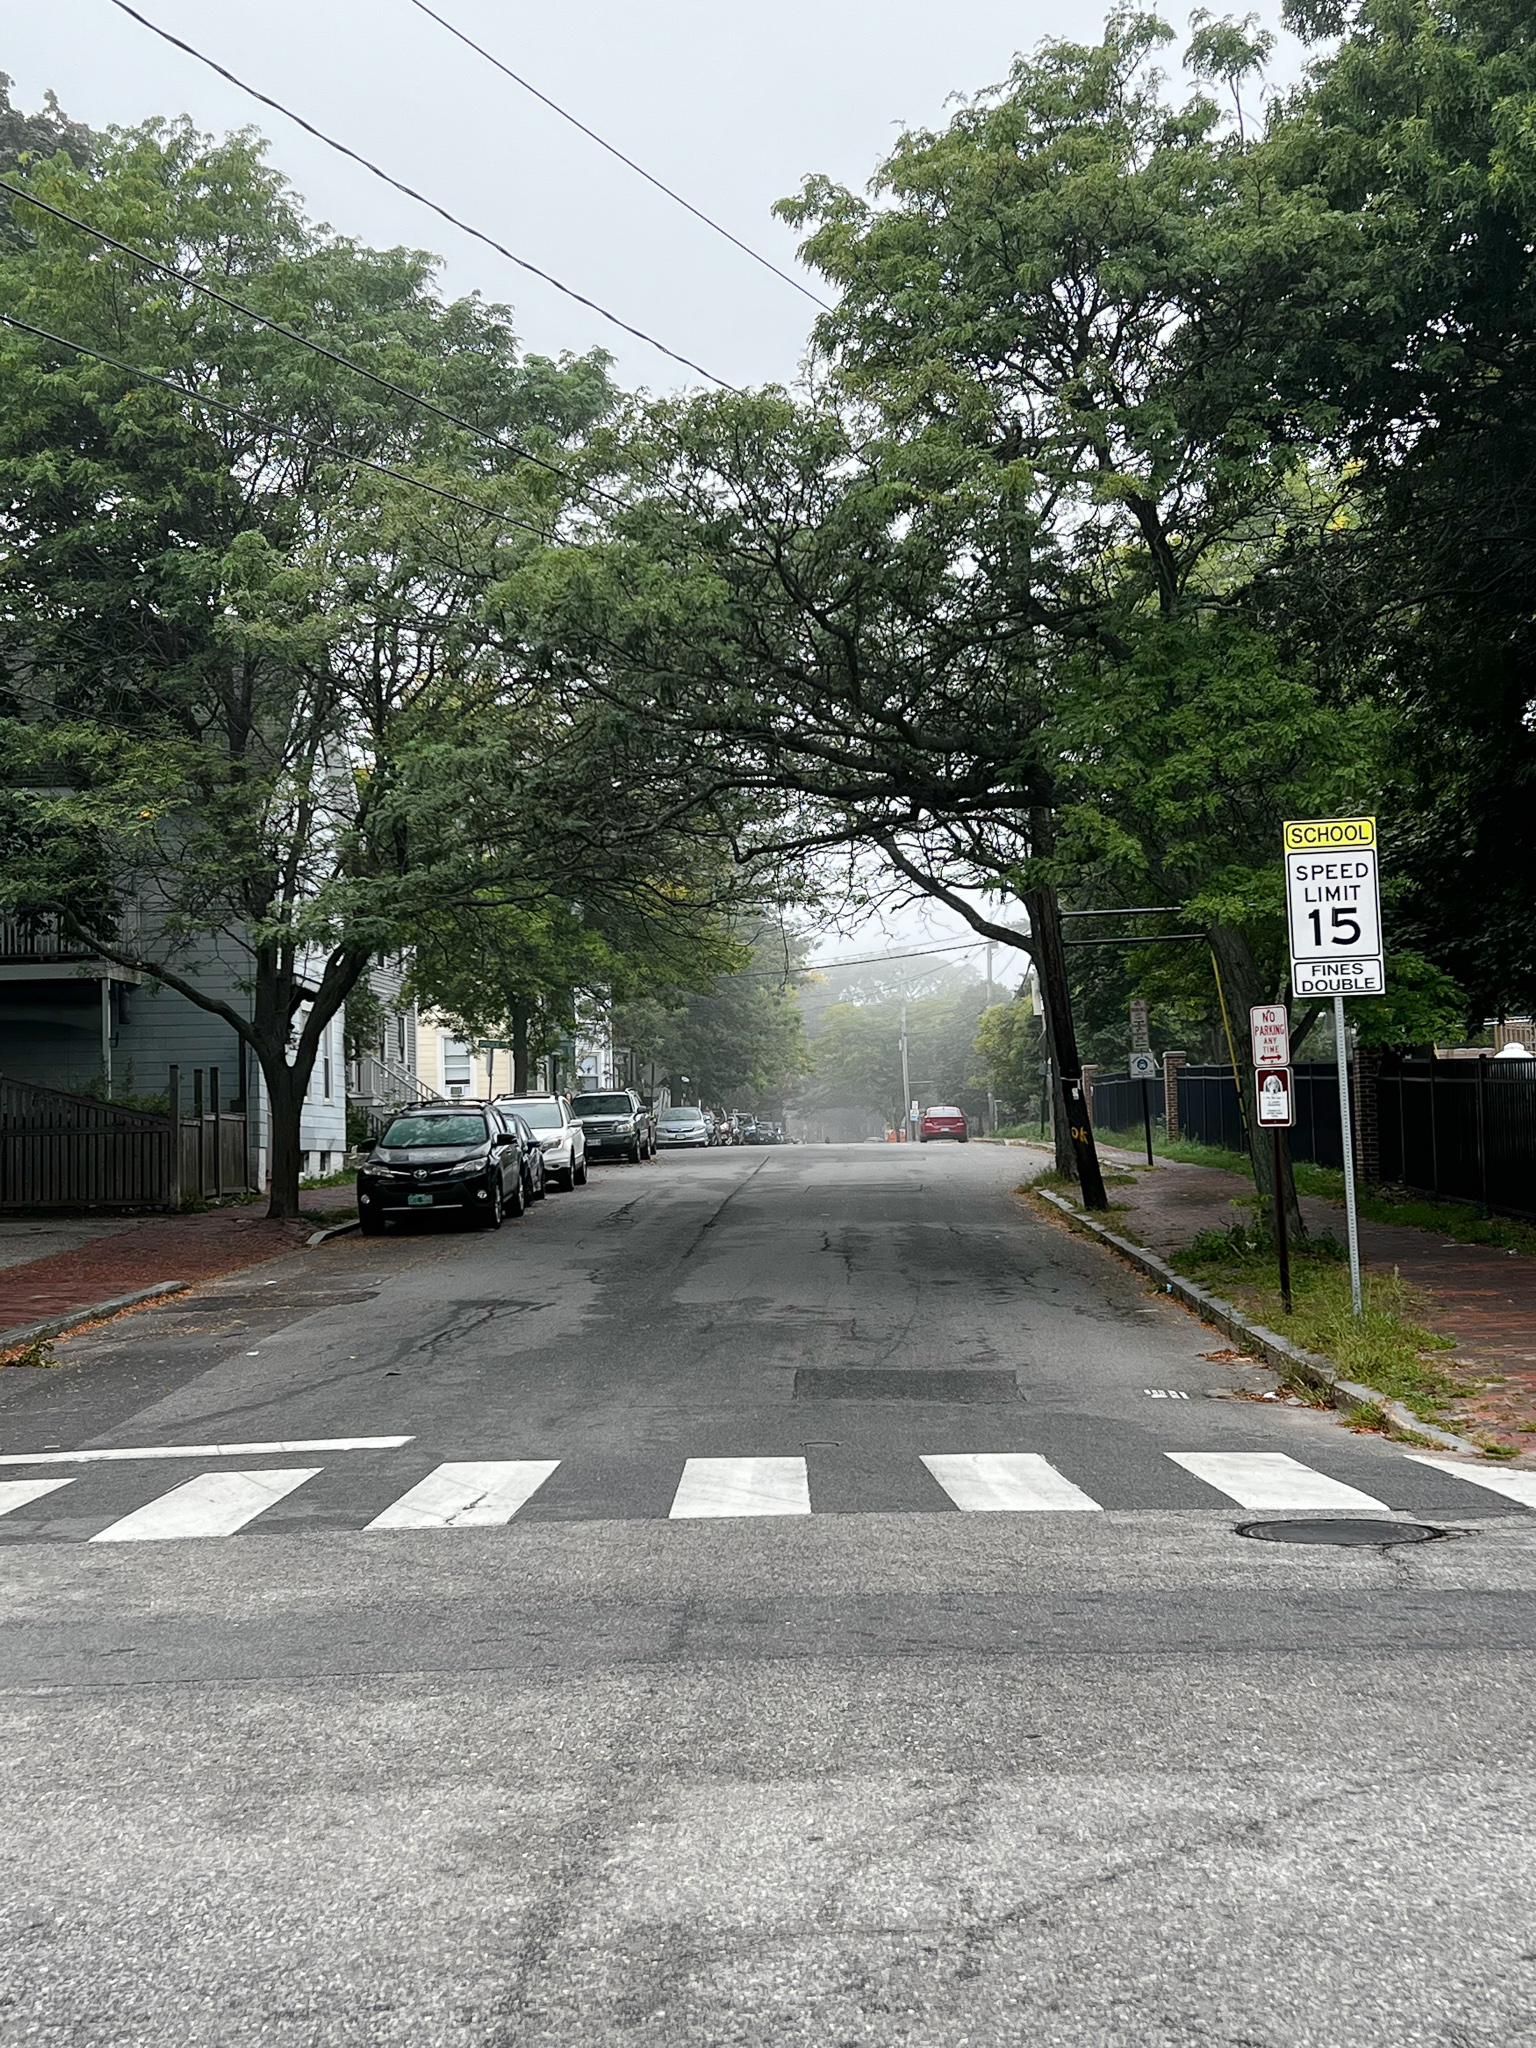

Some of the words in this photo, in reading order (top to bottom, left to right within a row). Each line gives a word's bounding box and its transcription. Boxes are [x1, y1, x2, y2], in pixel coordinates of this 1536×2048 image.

[1291, 824, 1369, 844] SCHOOL
[1296, 862, 1369, 881] SPEED
[1305, 884, 1361, 903] LIMIT
[1308, 906, 1361, 947] 15
[1311, 962, 1364, 977] FINES
[1302, 977, 1376, 992] DOUBLE
[1262, 1011, 1276, 1023] NO
[1254, 1023, 1285, 1036] PARKING
[1263, 1037, 1277, 1045] ANY
[1262, 1045, 1279, 1054] TIME
